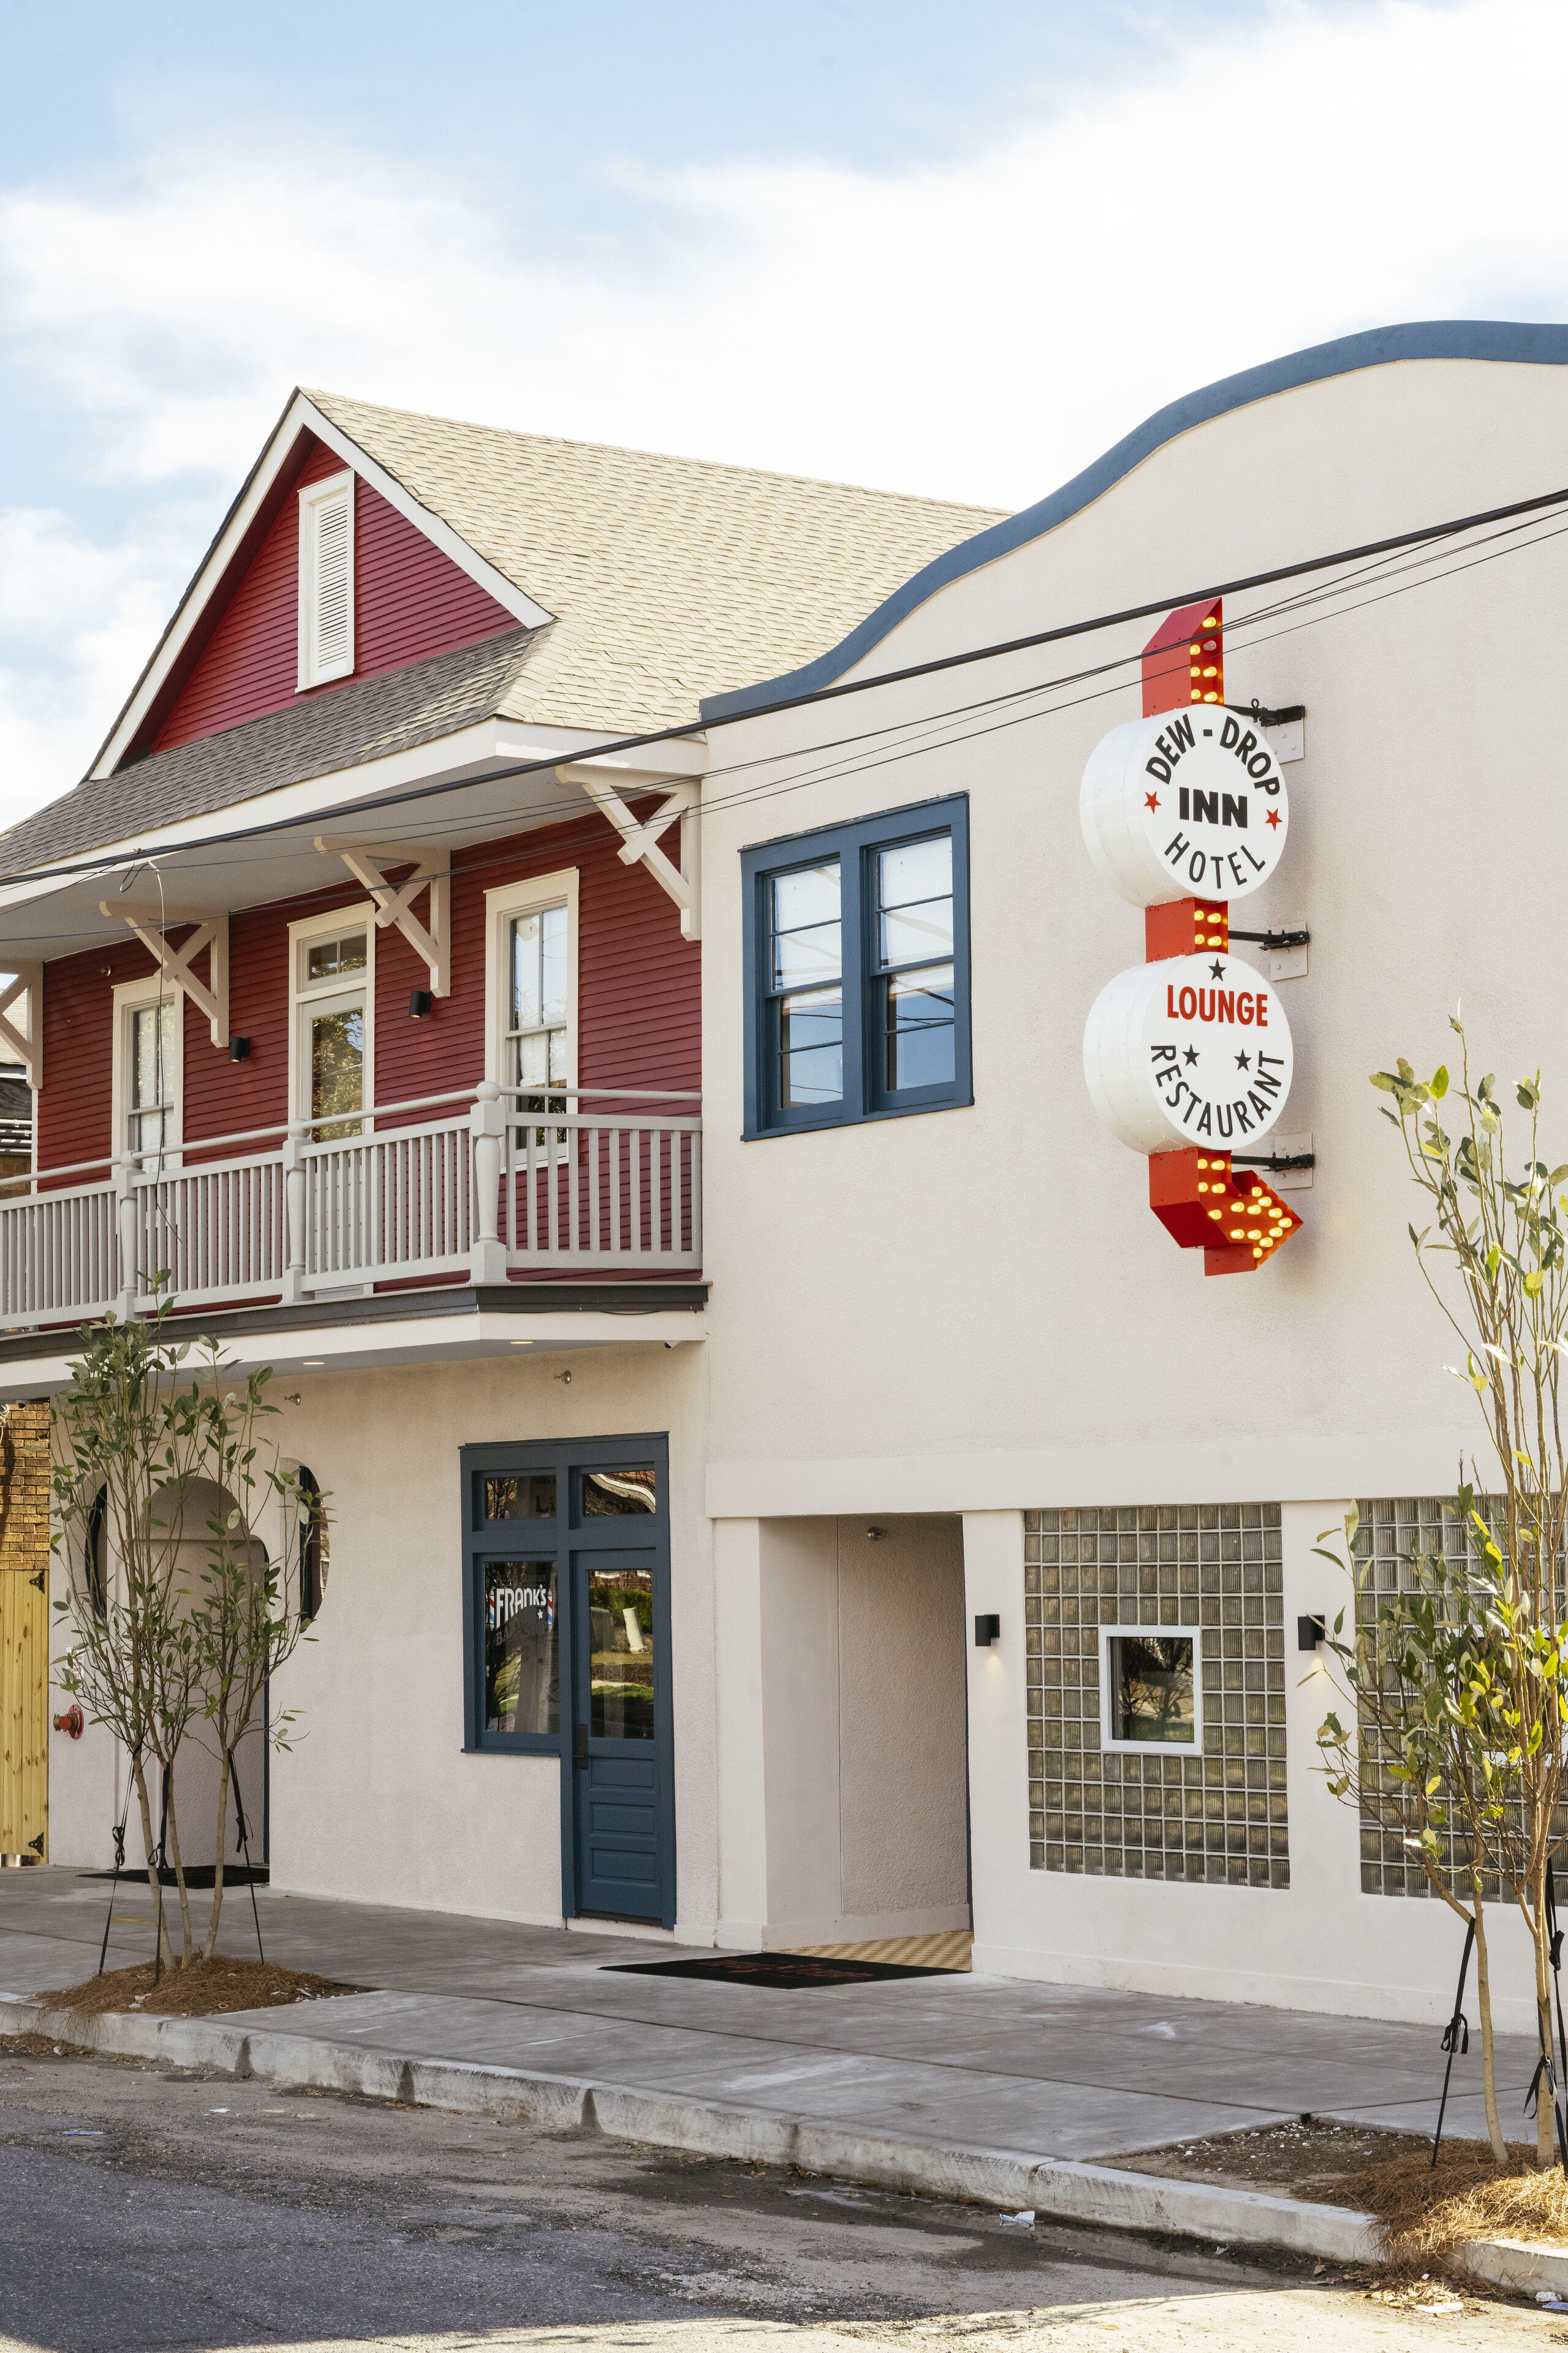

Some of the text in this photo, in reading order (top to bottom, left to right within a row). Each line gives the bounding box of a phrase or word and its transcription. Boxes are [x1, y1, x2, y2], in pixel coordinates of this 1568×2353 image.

[1145, 713, 1196, 785] DEW
[1219, 715, 1281, 796] DROP
[1179, 786, 1248, 828] INN
[1164, 831, 1266, 889] HOTEL
[1167, 984, 1268, 1027] LOUNGE
[1150, 1045, 1284, 1138] RESTAURANT
[496, 1583, 547, 1629] FRANK'S
